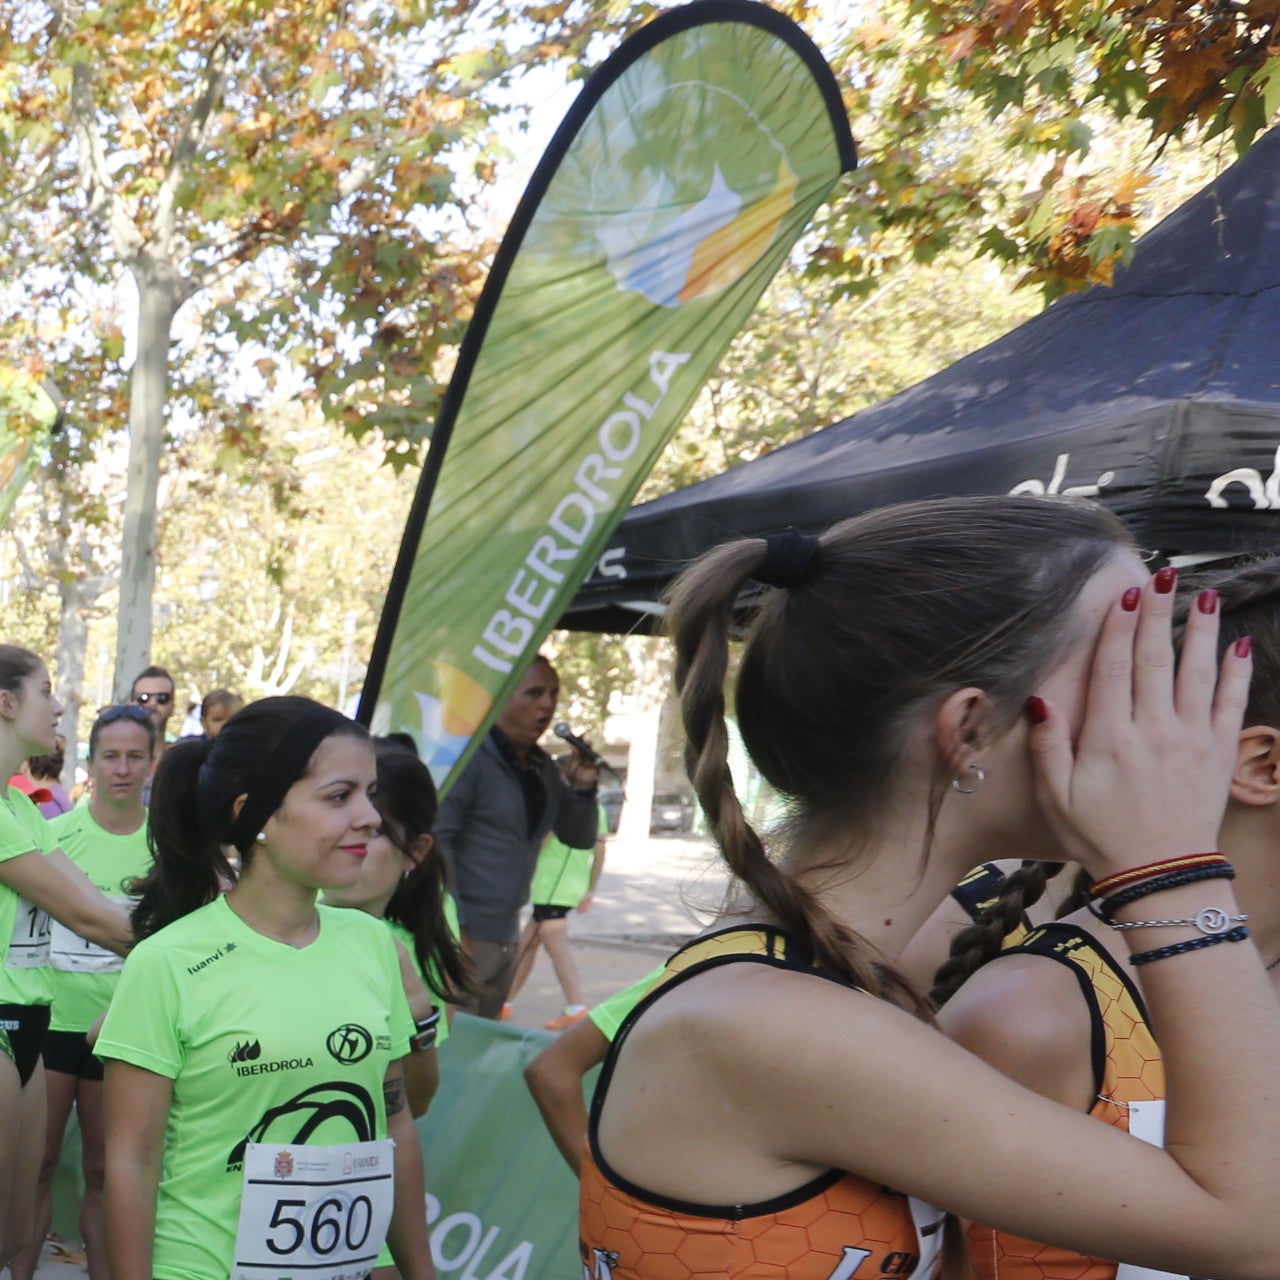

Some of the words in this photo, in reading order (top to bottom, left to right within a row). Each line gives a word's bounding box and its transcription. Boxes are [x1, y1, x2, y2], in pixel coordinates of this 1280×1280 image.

[473, 350, 692, 674] IBERDROLA
[187, 949, 224, 975] luanvi
[237, 1057, 314, 1077] IBERDROLA
[226, 1164, 242, 1173] EN
[265, 1194, 373, 1255] 560
